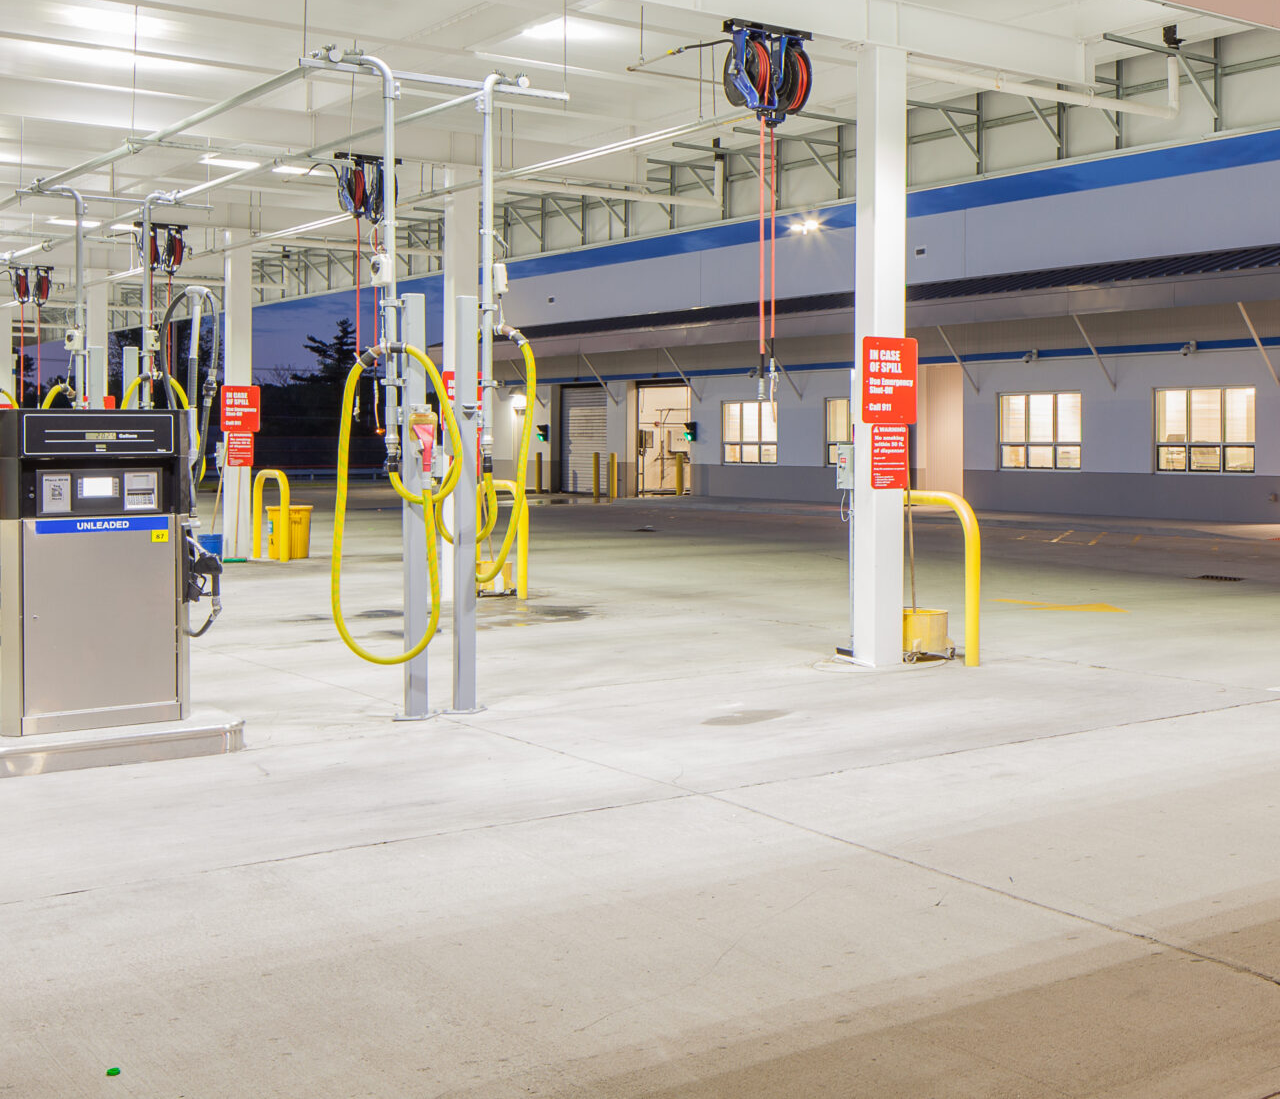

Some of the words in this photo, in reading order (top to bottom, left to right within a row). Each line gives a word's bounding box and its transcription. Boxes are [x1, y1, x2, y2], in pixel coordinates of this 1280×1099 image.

[869, 349, 879, 360] IN
[880, 349, 901, 361] CASE
[869, 361, 880, 373] OF
[881, 362, 902, 373] SPILL
[869, 377, 880, 385] Use
[881, 377, 914, 387] Emergency
[869, 386, 893, 394] Shut-Off
[869, 402, 881, 411] Call
[881, 403, 892, 411] 911
[76, 520, 130, 530] UNLEADED
